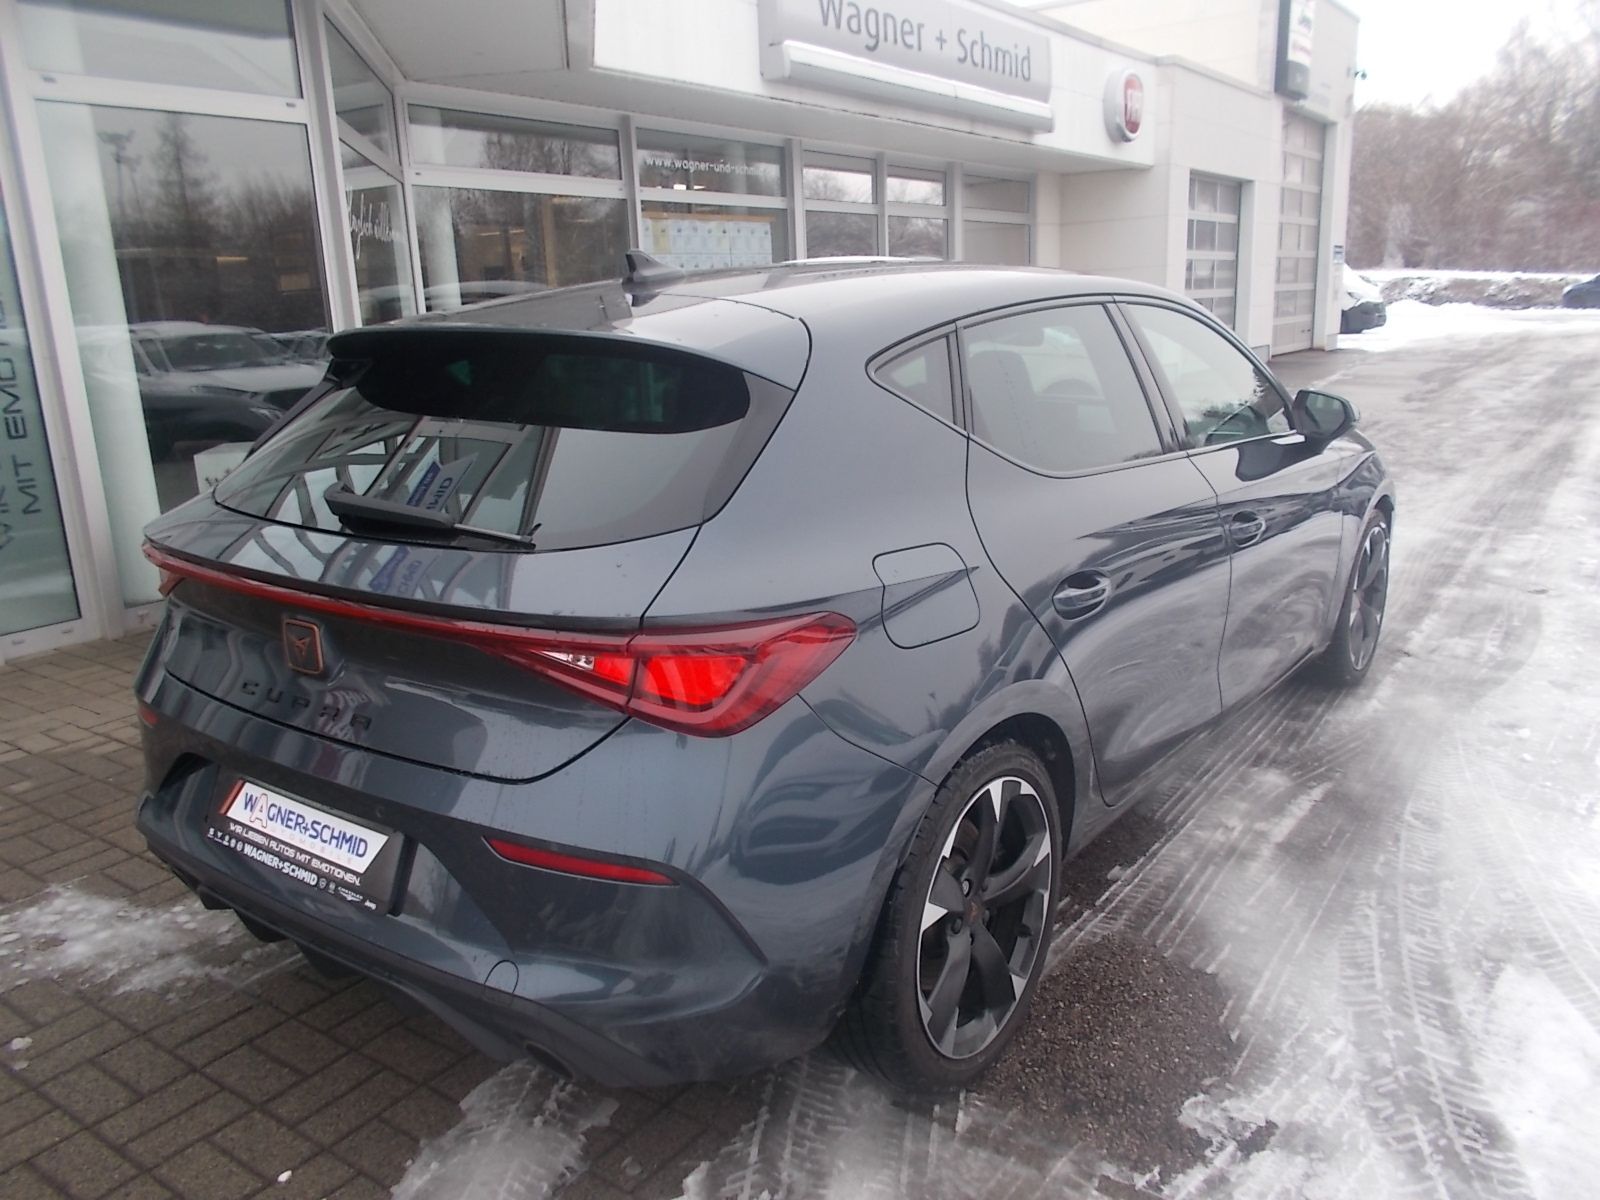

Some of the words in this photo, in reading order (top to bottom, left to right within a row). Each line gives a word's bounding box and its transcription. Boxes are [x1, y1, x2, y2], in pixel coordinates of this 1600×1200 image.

[818, 0, 925, 52] Wagner
[935, 29, 948, 51] +
[957, 28, 1031, 82] Schmid
[11, 454, 42, 515] MIT
[229, 822, 244, 836] WIR
[243, 827, 270, 847] LIEBEN
[268, 839, 296, 860] AUTOS
[295, 850, 310, 865] MIT
[243, 842, 319, 887] WAGNER+SCHMID
